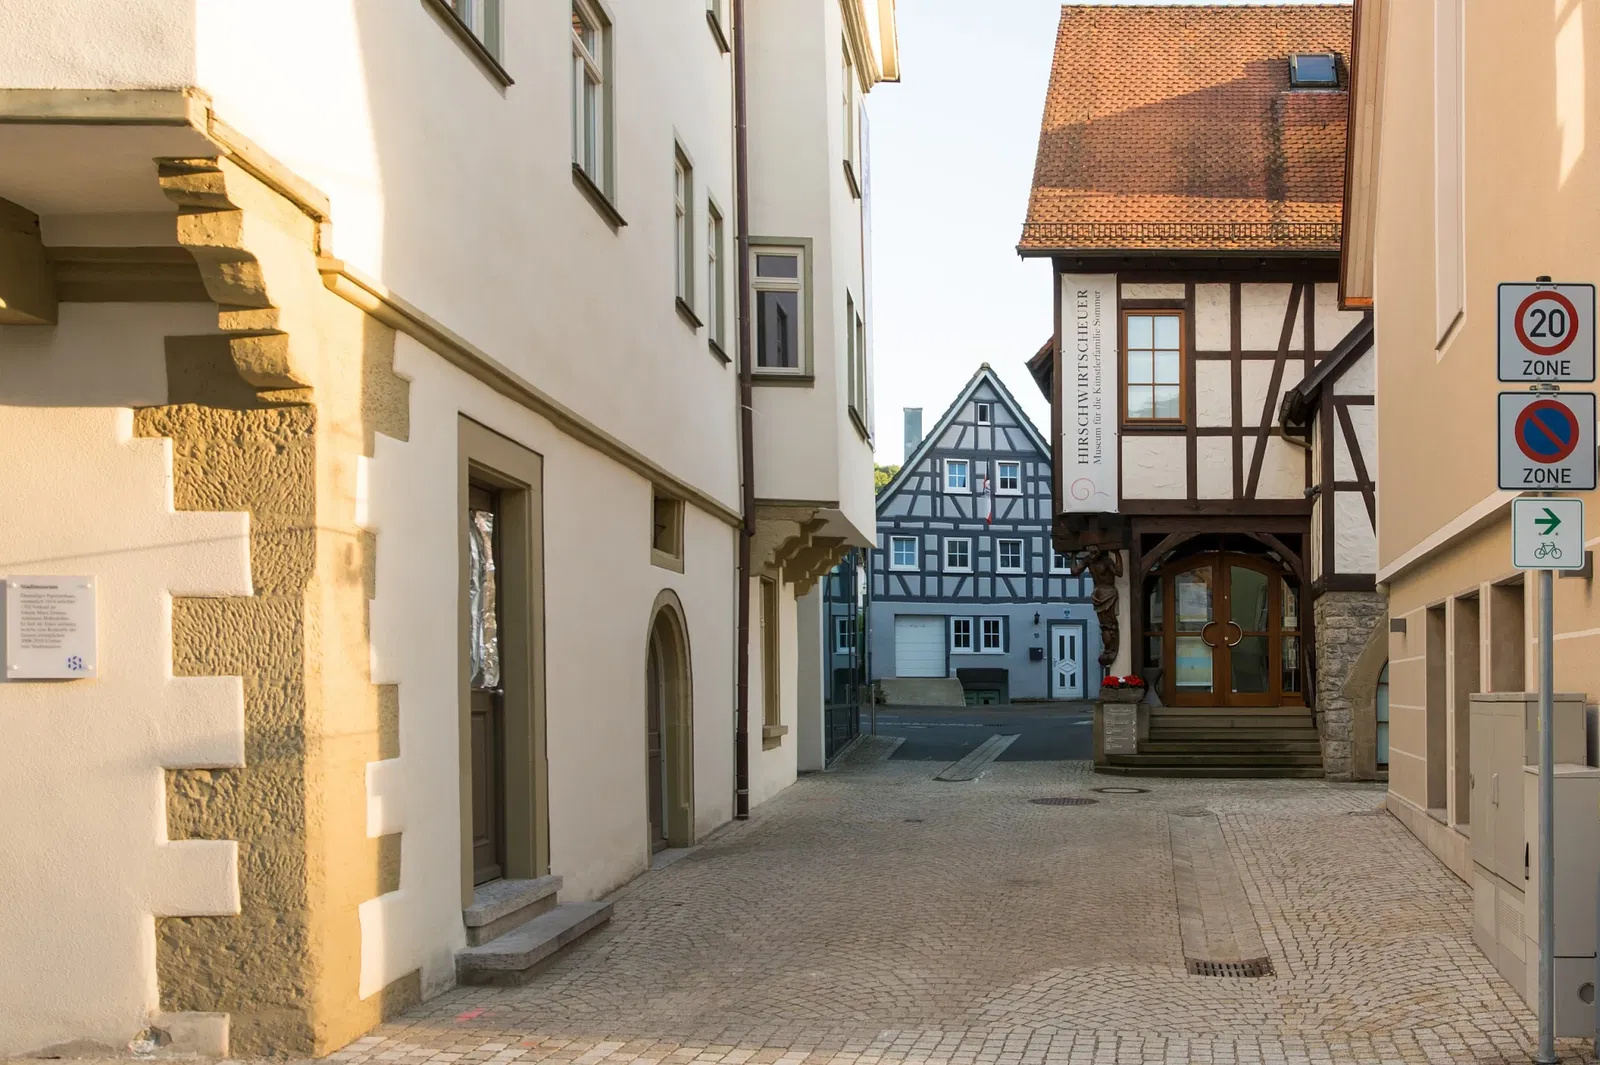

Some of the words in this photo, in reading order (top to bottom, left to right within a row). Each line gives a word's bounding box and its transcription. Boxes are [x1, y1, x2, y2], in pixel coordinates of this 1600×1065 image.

[1093, 290, 1101, 327] Sommer
[1529, 308, 1565, 338] 20
[1093, 329, 1101, 394] Künstlerfamilie
[1522, 360, 1571, 376] ZONE
[1077, 289, 1089, 465] HIRSCHWIRTSCHEUER
[1093, 396, 1101, 410] die
[1093, 412, 1102, 425] für
[1093, 427, 1102, 465] Museum
[1523, 468, 1572, 484] ZONE
